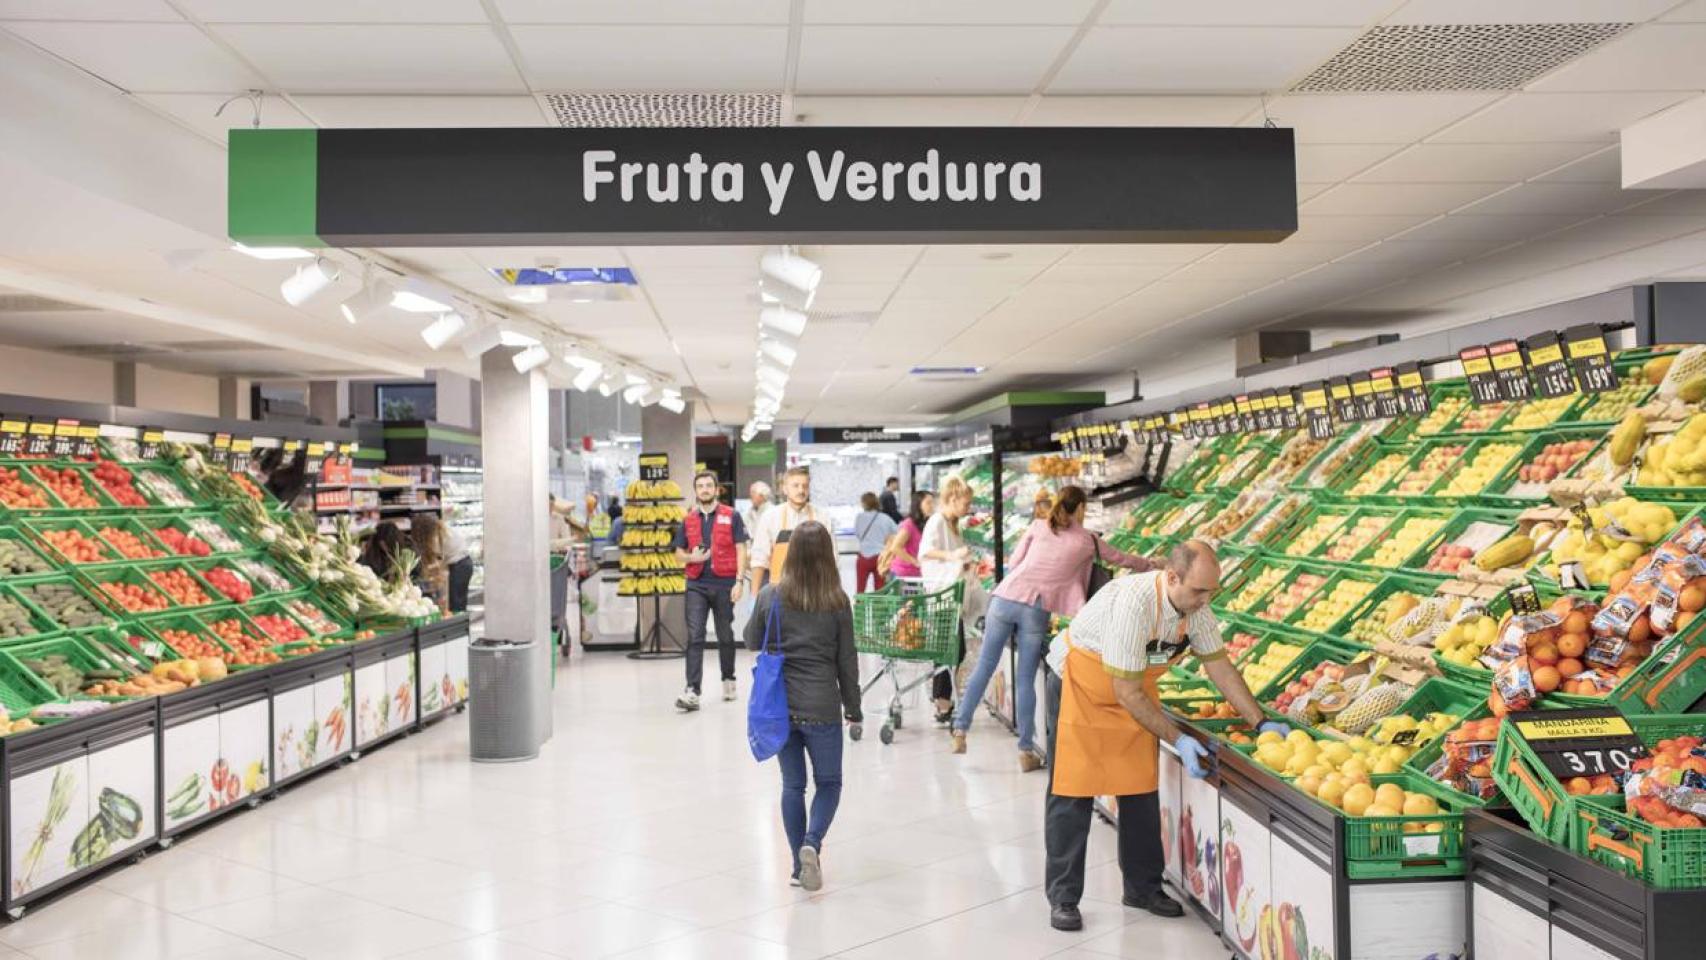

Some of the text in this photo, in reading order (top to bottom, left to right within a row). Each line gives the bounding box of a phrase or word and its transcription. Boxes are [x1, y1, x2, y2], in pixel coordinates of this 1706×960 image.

[582, 148, 1042, 216] Fruta y Verdura
[1533, 717, 1609, 729] MANDARINA
